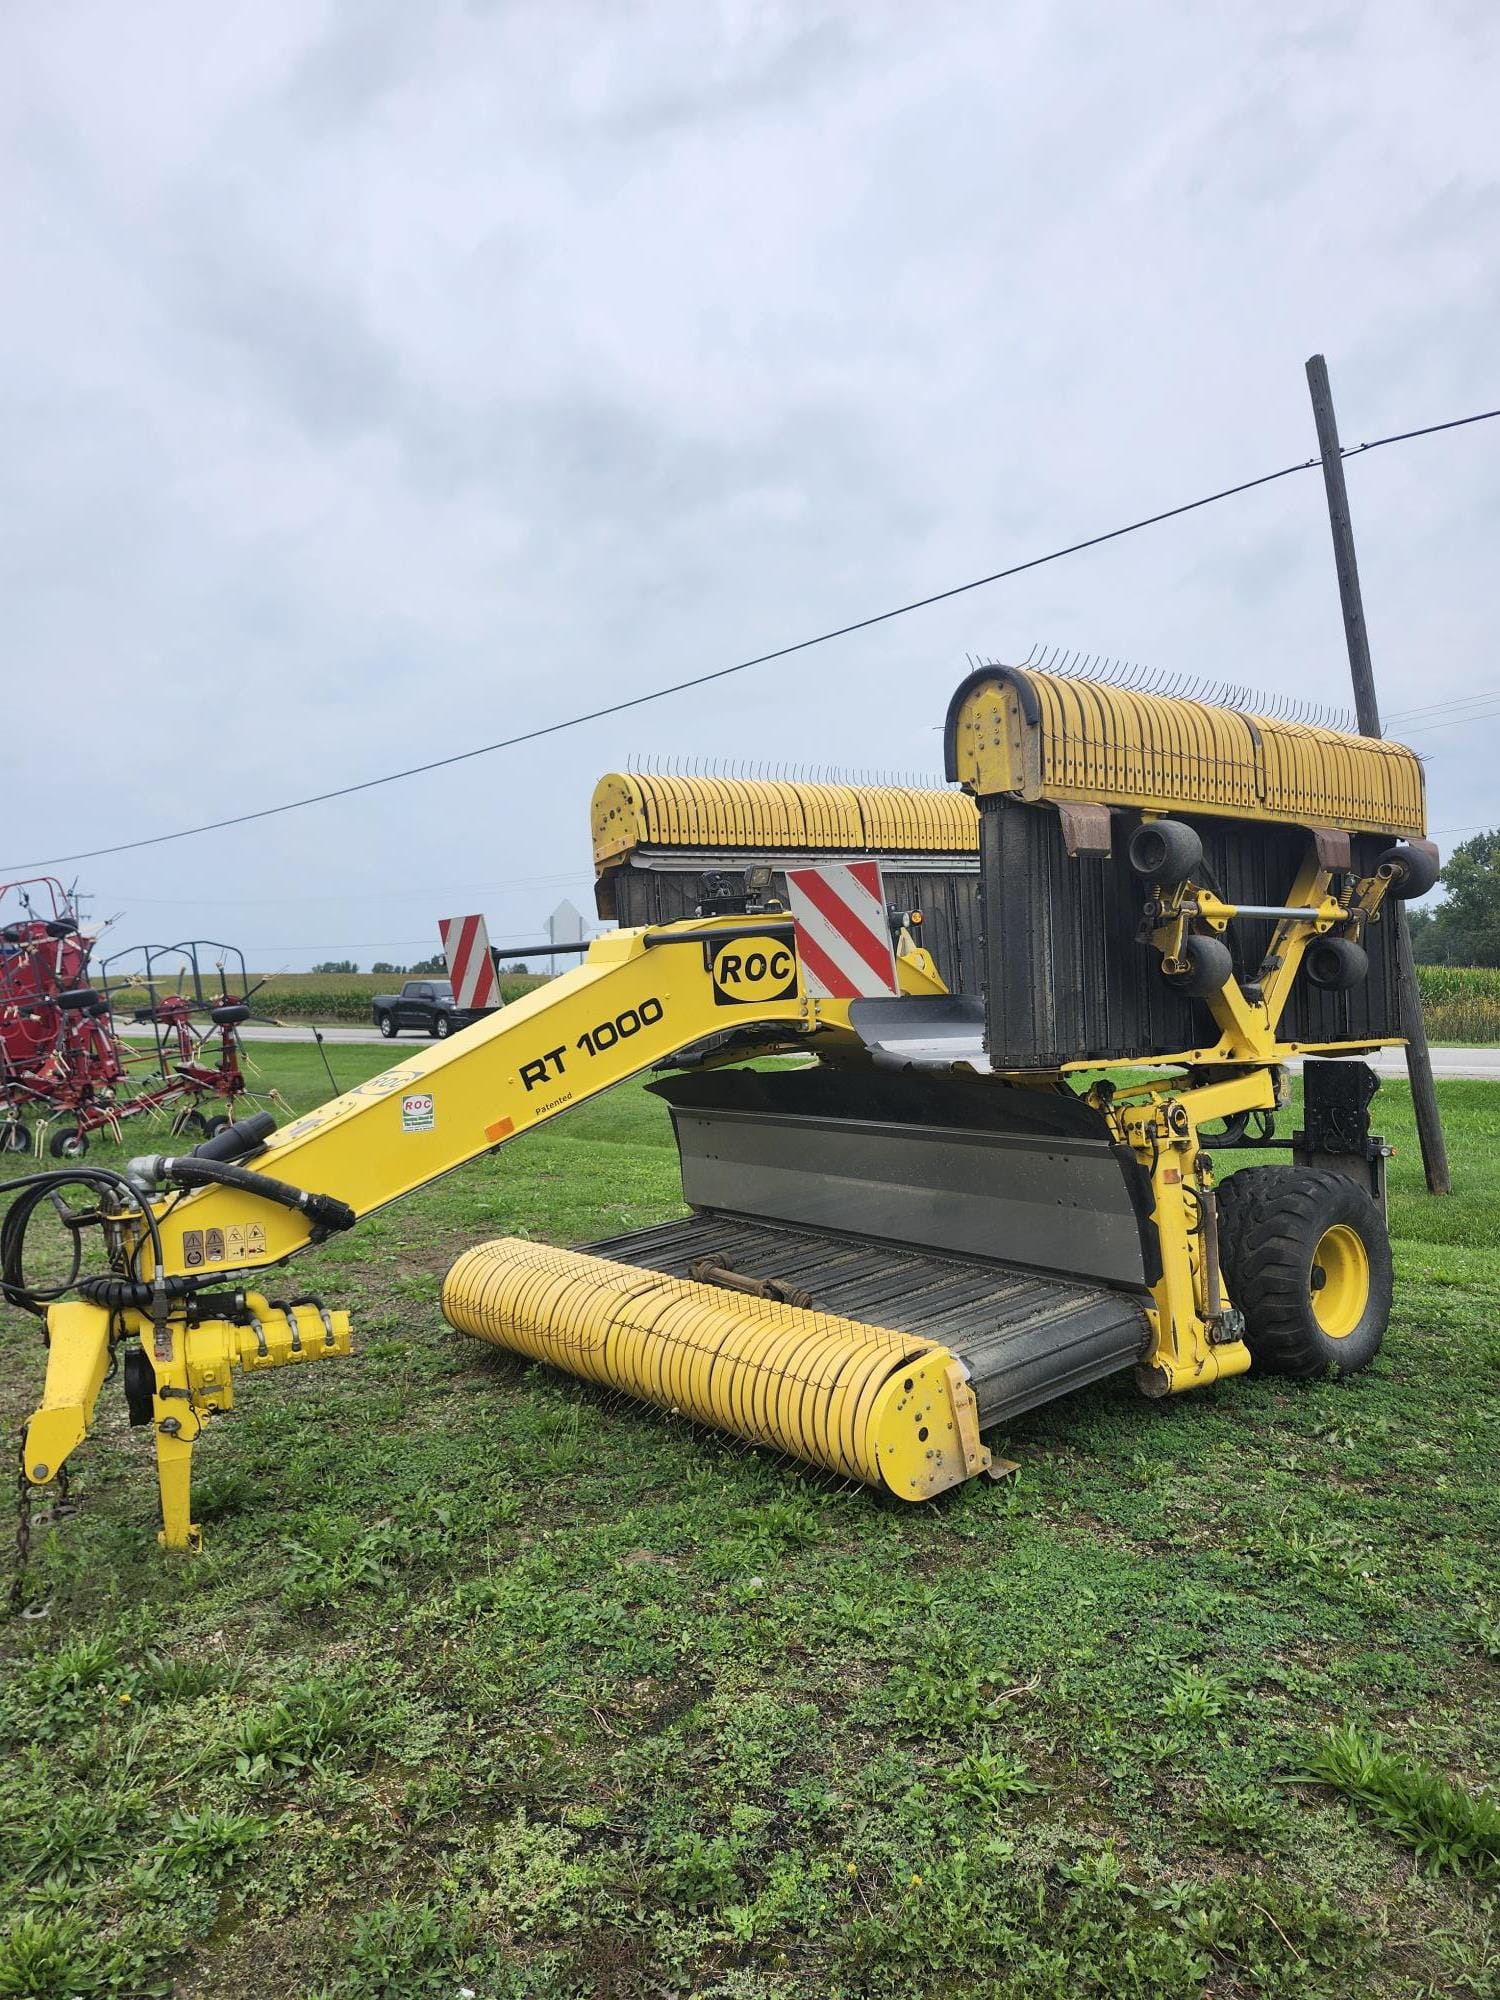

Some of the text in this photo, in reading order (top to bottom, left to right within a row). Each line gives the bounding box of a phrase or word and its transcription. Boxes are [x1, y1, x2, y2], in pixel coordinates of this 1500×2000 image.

[719, 951, 791, 985] ROC
[518, 997, 664, 1092] RT 1000
[405, 1100, 432, 1111] ROC
[535, 1092, 573, 1117] Patented
